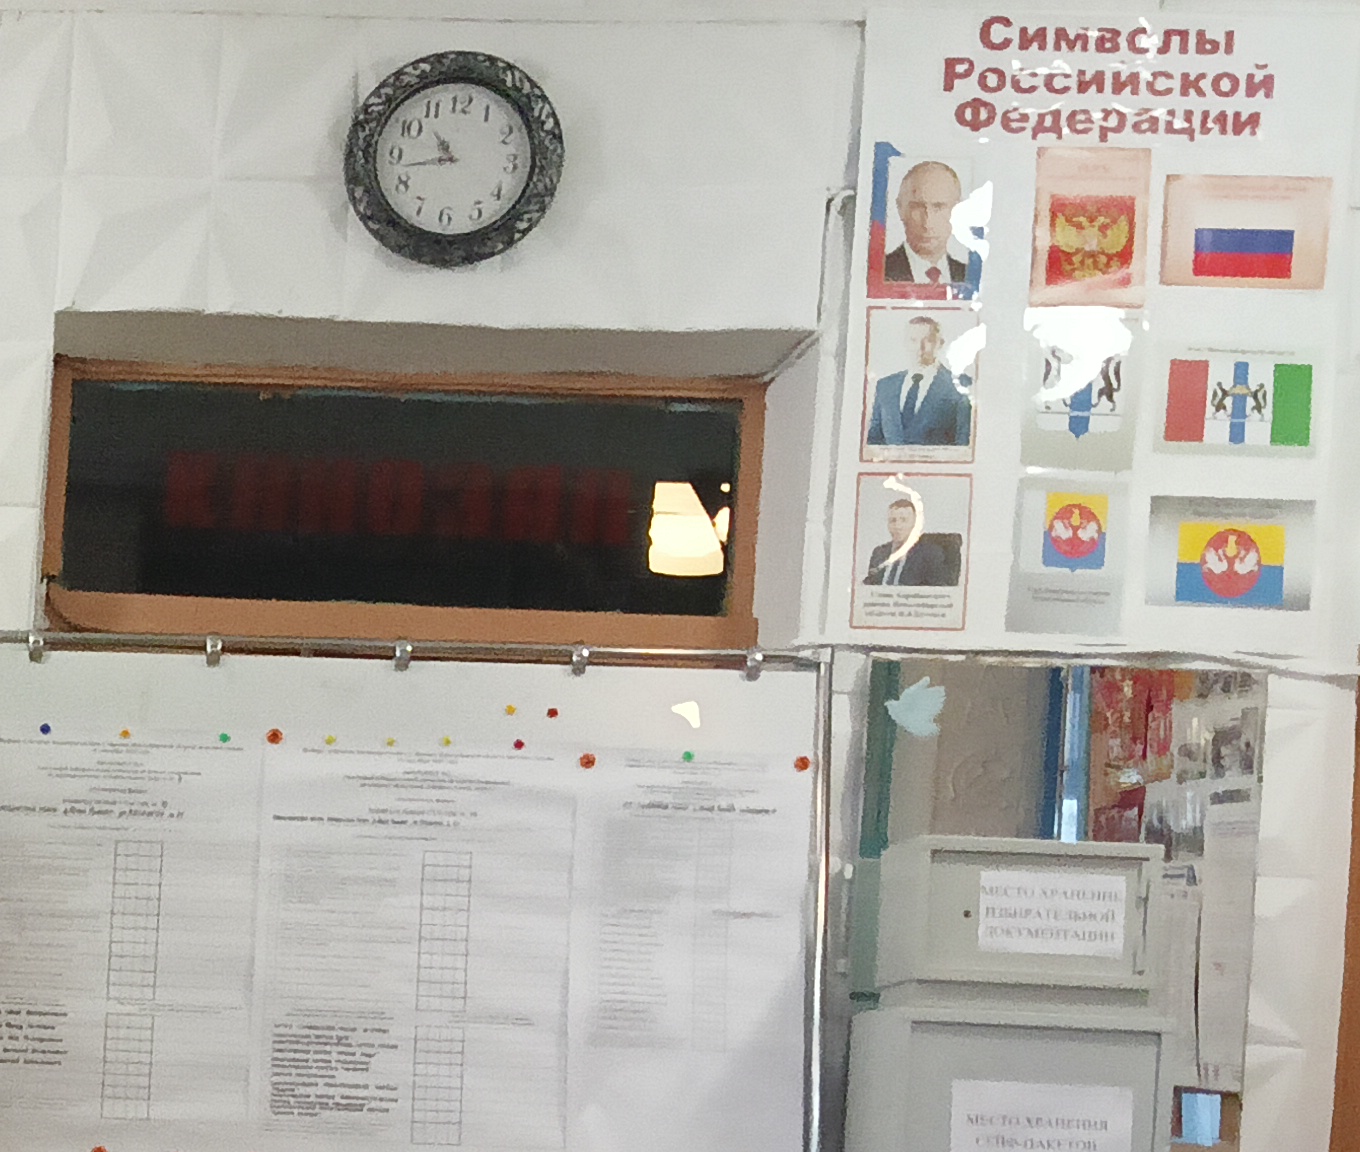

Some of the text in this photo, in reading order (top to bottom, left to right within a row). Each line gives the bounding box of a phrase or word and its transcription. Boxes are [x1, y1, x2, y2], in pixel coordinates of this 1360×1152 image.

[980, 15, 1235, 57] Символы
[943, 57, 1276, 99] Российской
[424, 100, 442, 119] 11
[452, 94, 473, 115] 12
[483, 104, 490, 122] 1
[401, 118, 423, 139] 10
[954, 97, 1262, 142] Федерации
[501, 124, 513, 145] 2
[389, 144, 403, 165] 9
[503, 153, 518, 174] 3
[395, 171, 411, 194] 8
[490, 180, 503, 201] 4
[416, 196, 425, 217] 7
[438, 206, 452, 227] 6
[469, 200, 483, 221] 5
